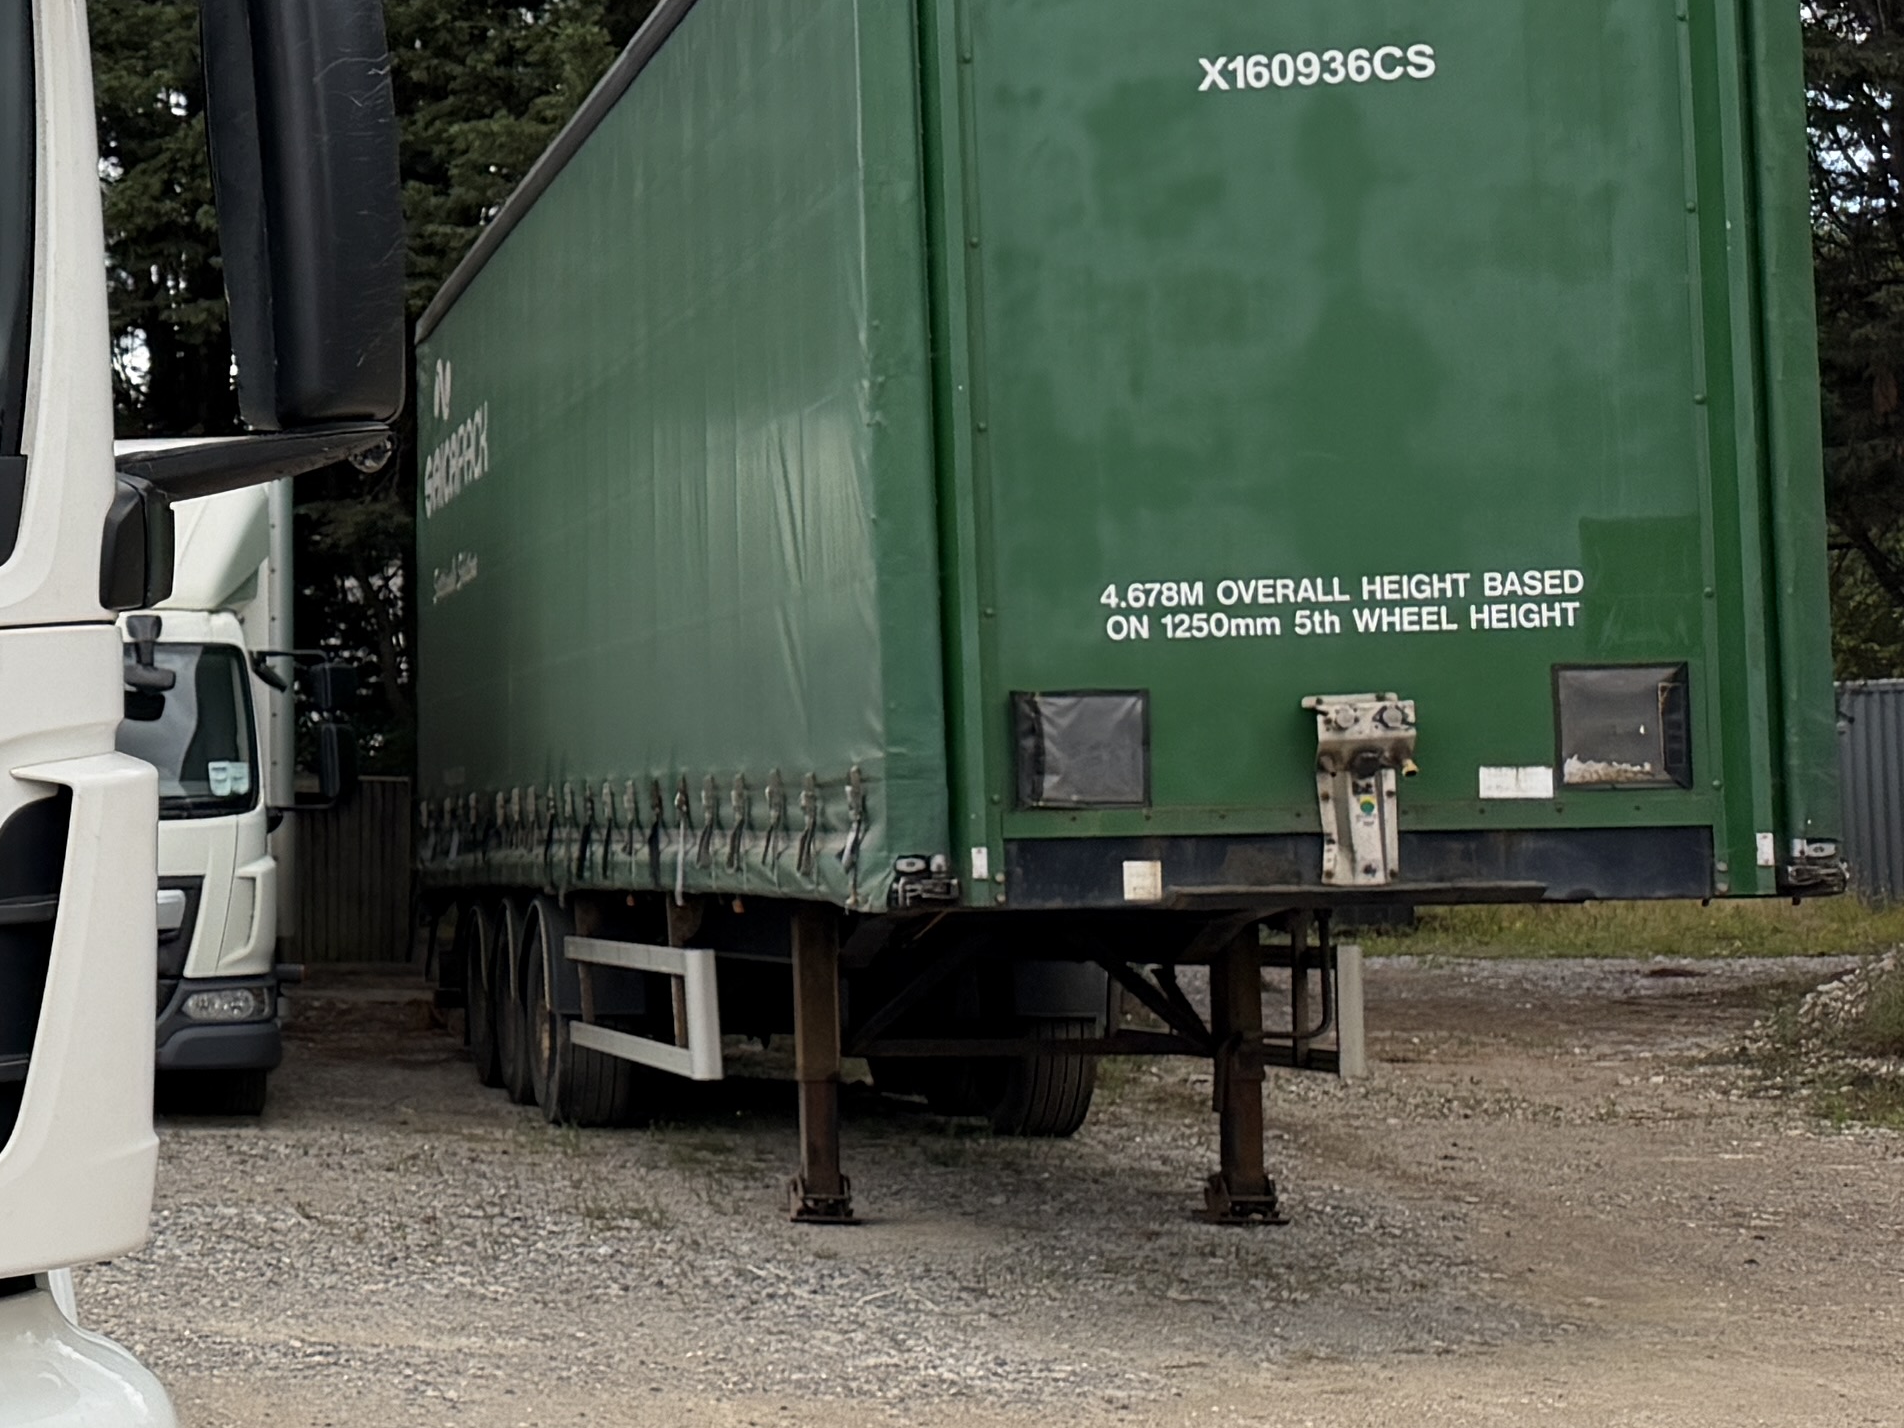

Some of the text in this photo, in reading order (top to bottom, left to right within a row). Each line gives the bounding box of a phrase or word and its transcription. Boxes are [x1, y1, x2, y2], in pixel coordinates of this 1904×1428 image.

[1197, 43, 1437, 92] X160936CS
[1099, 569, 1585, 609] 4.678M OVERALL HEIGHT BASED
[1106, 601, 1581, 641] ON 1250mm 5th WHEEL HEIGHT
